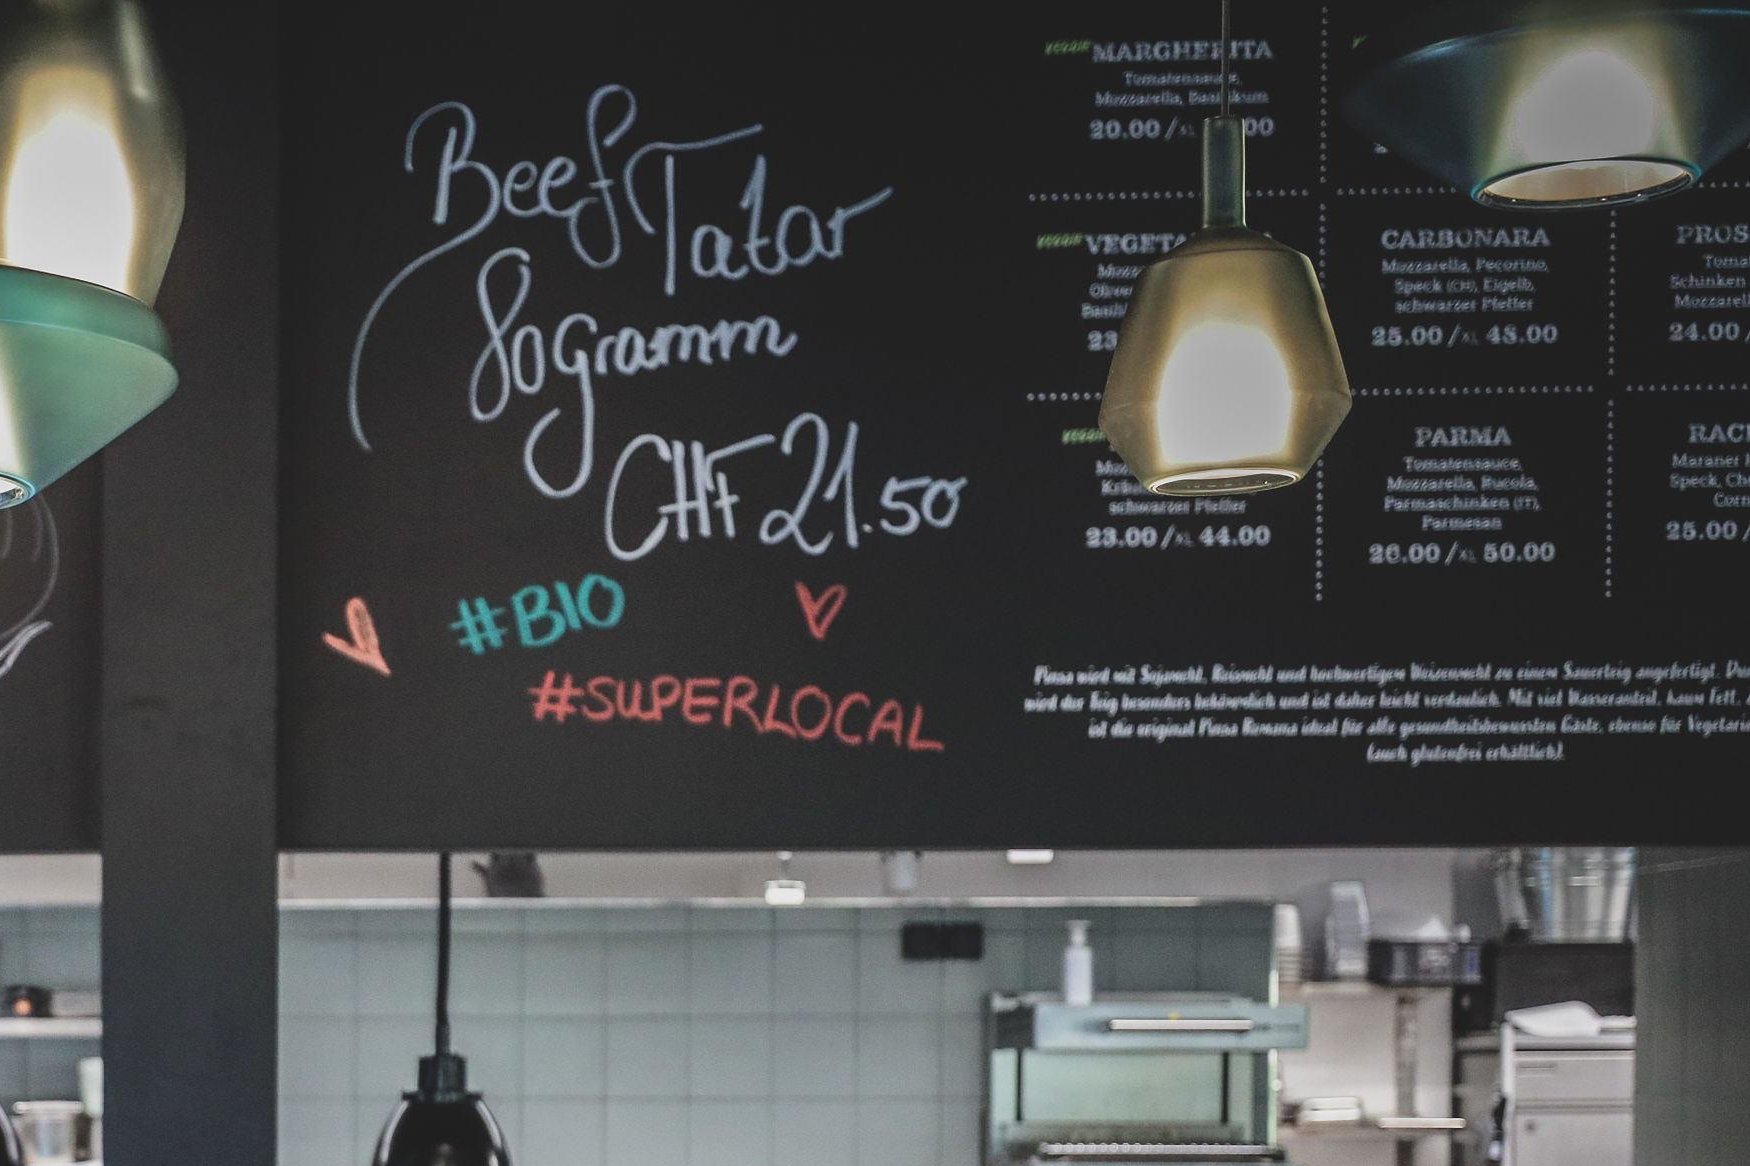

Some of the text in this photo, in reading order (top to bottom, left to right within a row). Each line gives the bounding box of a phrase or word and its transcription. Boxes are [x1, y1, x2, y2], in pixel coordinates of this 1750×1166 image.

[1123, 71, 1242, 87] Tomatensaue,
[1089, 118, 1160, 140] 20.00
[622, 124, 893, 296] Tatar
[1380, 227, 1552, 250] CARBONARA
[1675, 224, 1750, 244] PROS
[1702, 252, 1750, 269] Toma
[1394, 277, 1443, 296] Speck
[1669, 272, 1746, 289] Schinken
[1371, 325, 1443, 346] 25.00
[1668, 320, 1740, 342] 24.00
[1414, 426, 1512, 447] PARMA
[1688, 423, 1750, 444] RAC
[606, 412, 968, 560] CHF 21.50
[1421, 514, 1502, 531] Parmesan
[1666, 520, 1738, 541] 25.00
[1085, 526, 1158, 548] 23.00
[1199, 525, 1271, 547] 44.00
[1483, 541, 1556, 563] 50.00
[450, 573, 626, 655] #BIO
[528, 670, 945, 751] #SUPERLOCAL
